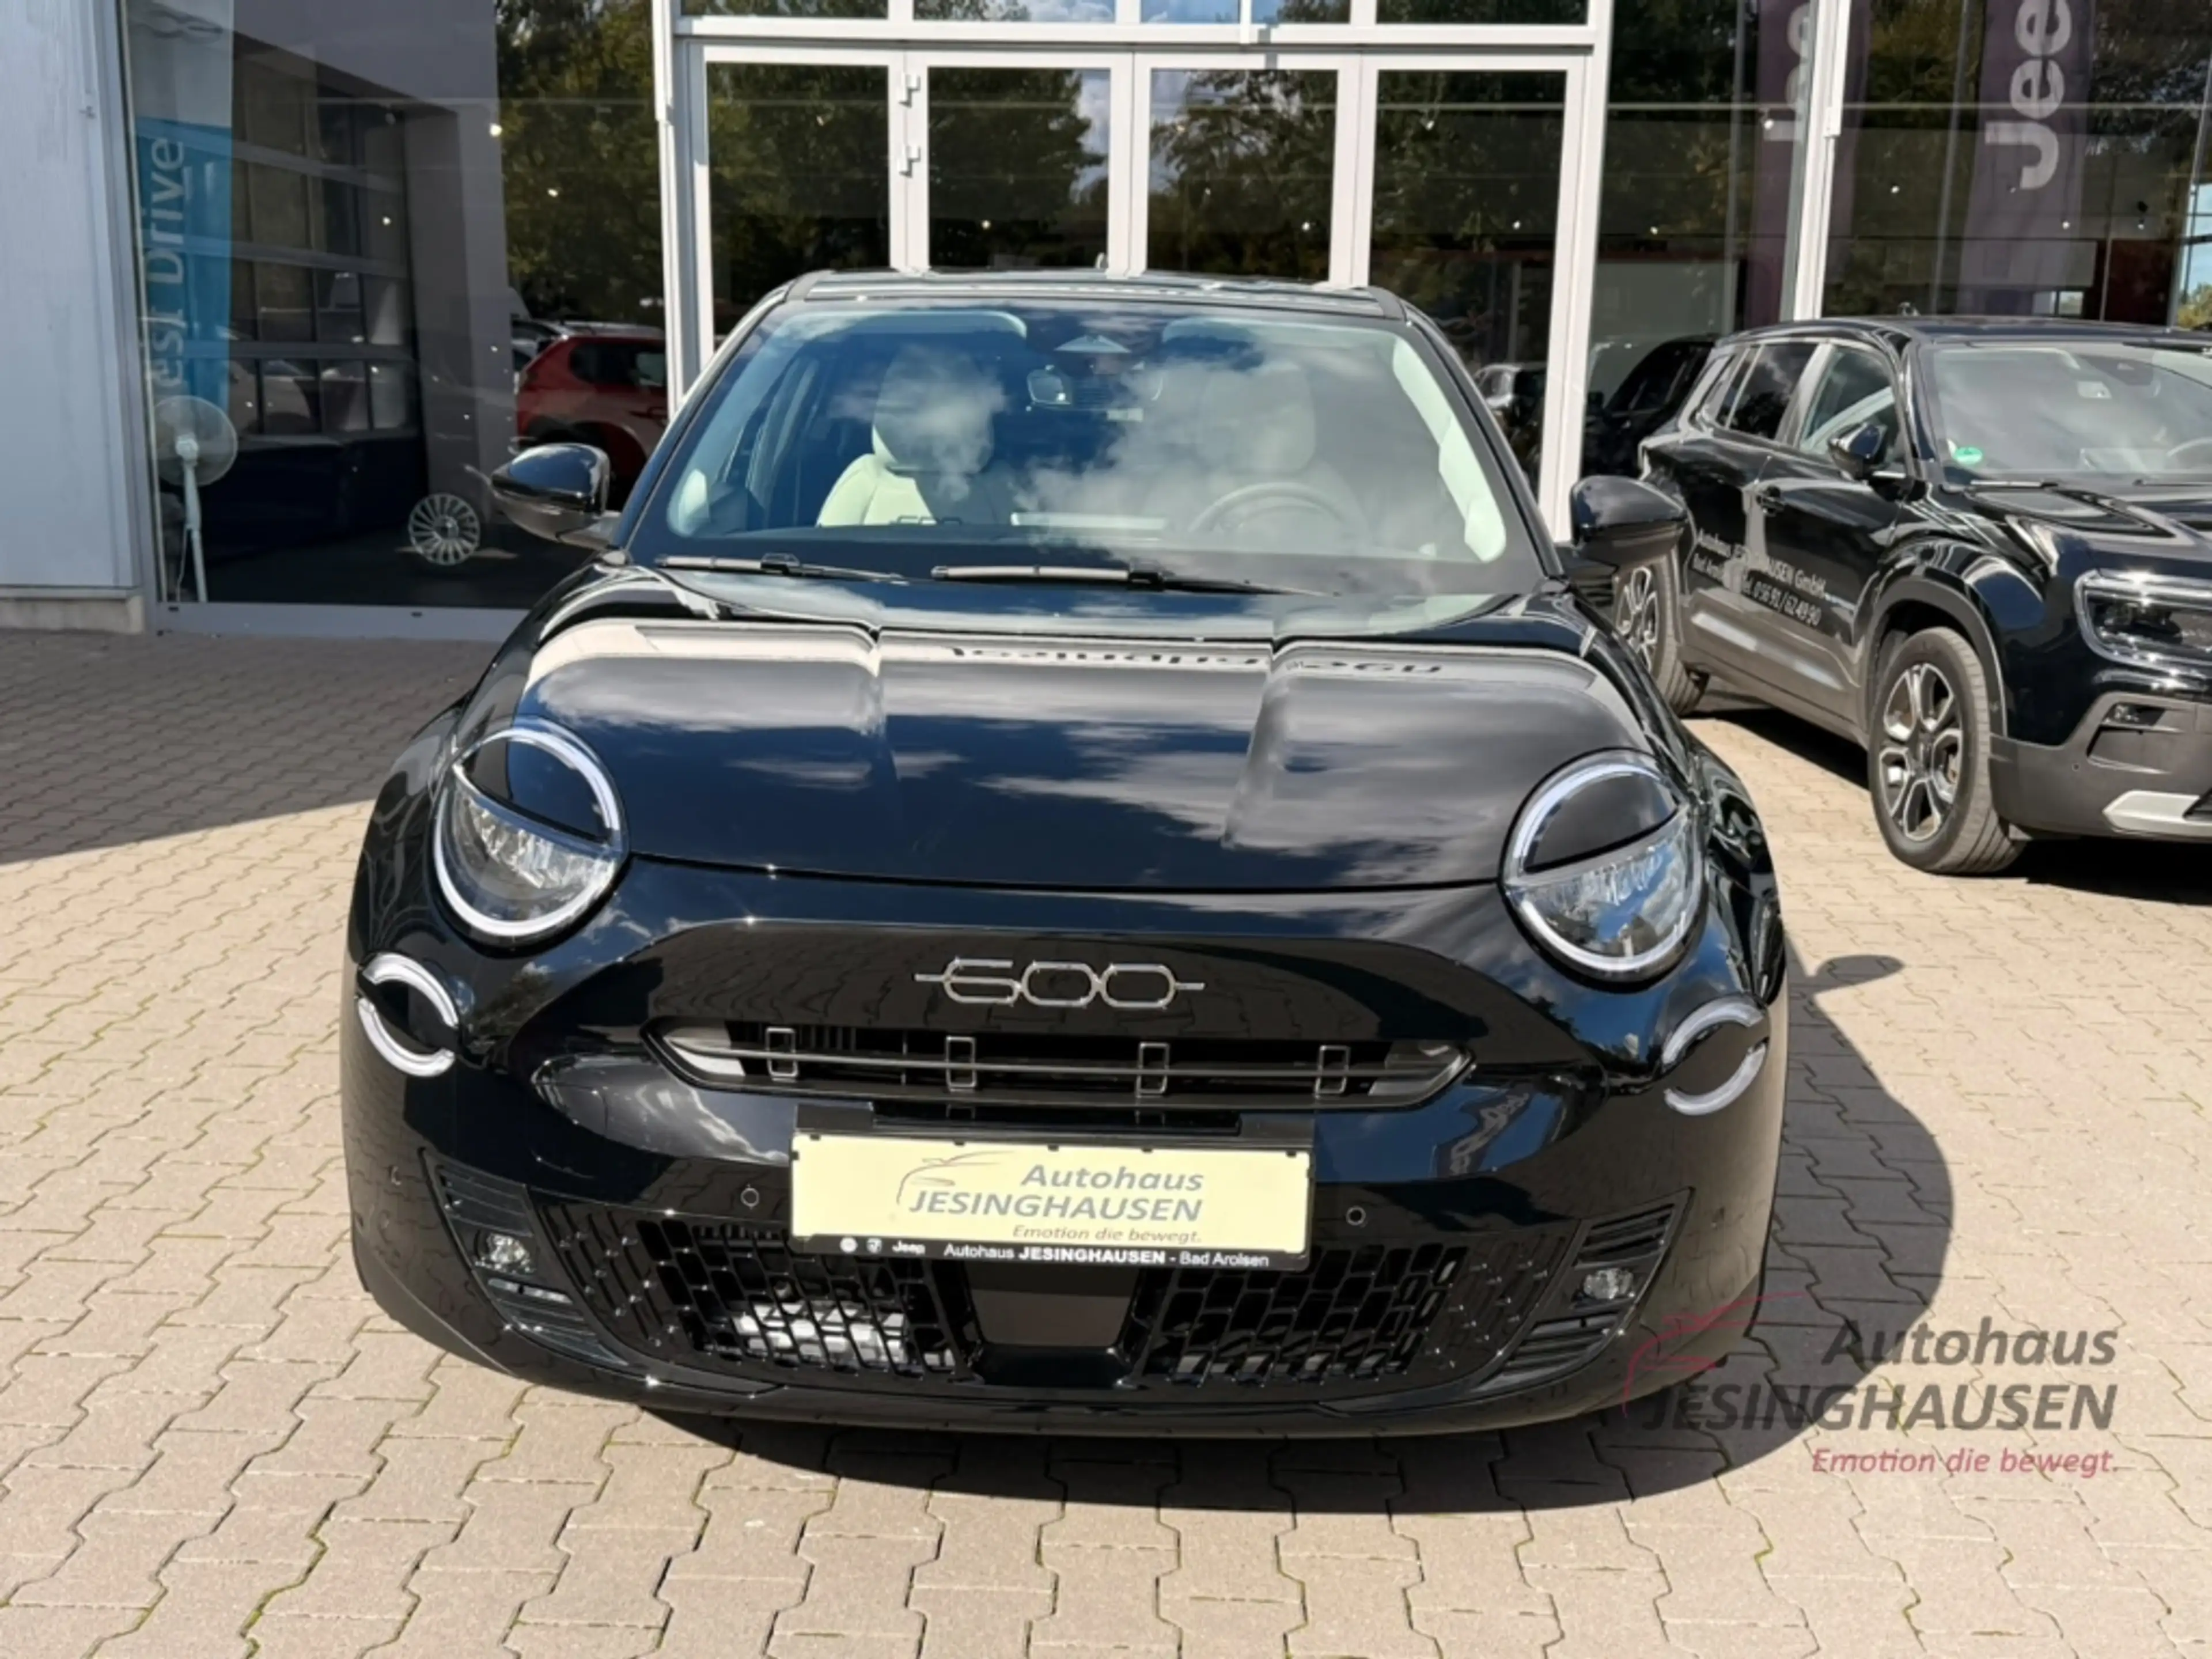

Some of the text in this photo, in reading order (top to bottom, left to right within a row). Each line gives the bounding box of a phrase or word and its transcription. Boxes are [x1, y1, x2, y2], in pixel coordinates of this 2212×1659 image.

[147, 138, 184, 284] Drive
[940, 957, 1179, 1008] 600
[1020, 1164, 1204, 1191] Autohaus
[909, 1190, 1203, 1221] JESINGHAUSEN
[1012, 1225, 1202, 1245] Emotion die bewegt.
[943, 1241, 1014, 1259] Autohaus
[1018, 1245, 1165, 1264] JESINGHAUSEN
[1180, 1251, 1209, 1266] Bad
[1213, 1252, 1269, 1267] Arolsen
